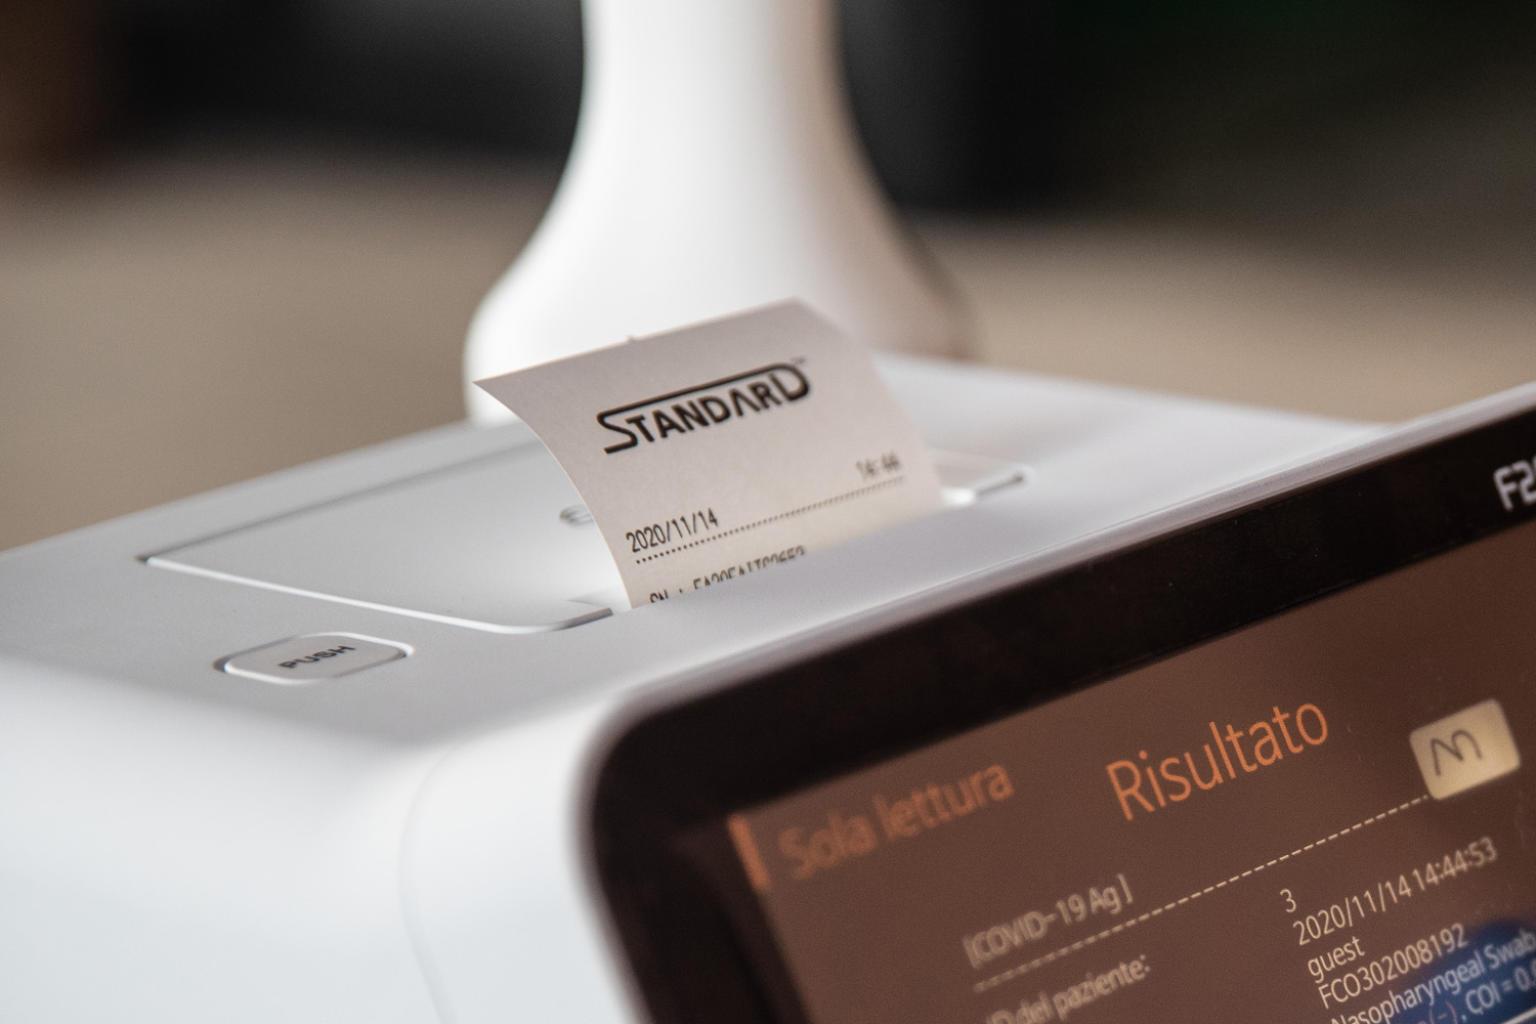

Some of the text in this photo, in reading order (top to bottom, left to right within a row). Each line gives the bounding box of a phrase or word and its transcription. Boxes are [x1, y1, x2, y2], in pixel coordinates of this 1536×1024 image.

[597, 363, 809, 454] STANDARD
[626, 508, 719, 553] 2020/11/14
[278, 645, 356, 669] PUSH
[1106, 703, 1329, 821] Risultato
[777, 763, 1014, 880] Sola lettura
[1293, 872, 1412, 947] 2020/11/14
[1412, 837, 1498, 897] 14:44:53
[1052, 954, 1151, 1021] paziente:
[1280, 888, 1297, 913] 3
[1306, 937, 1366, 983] guest
